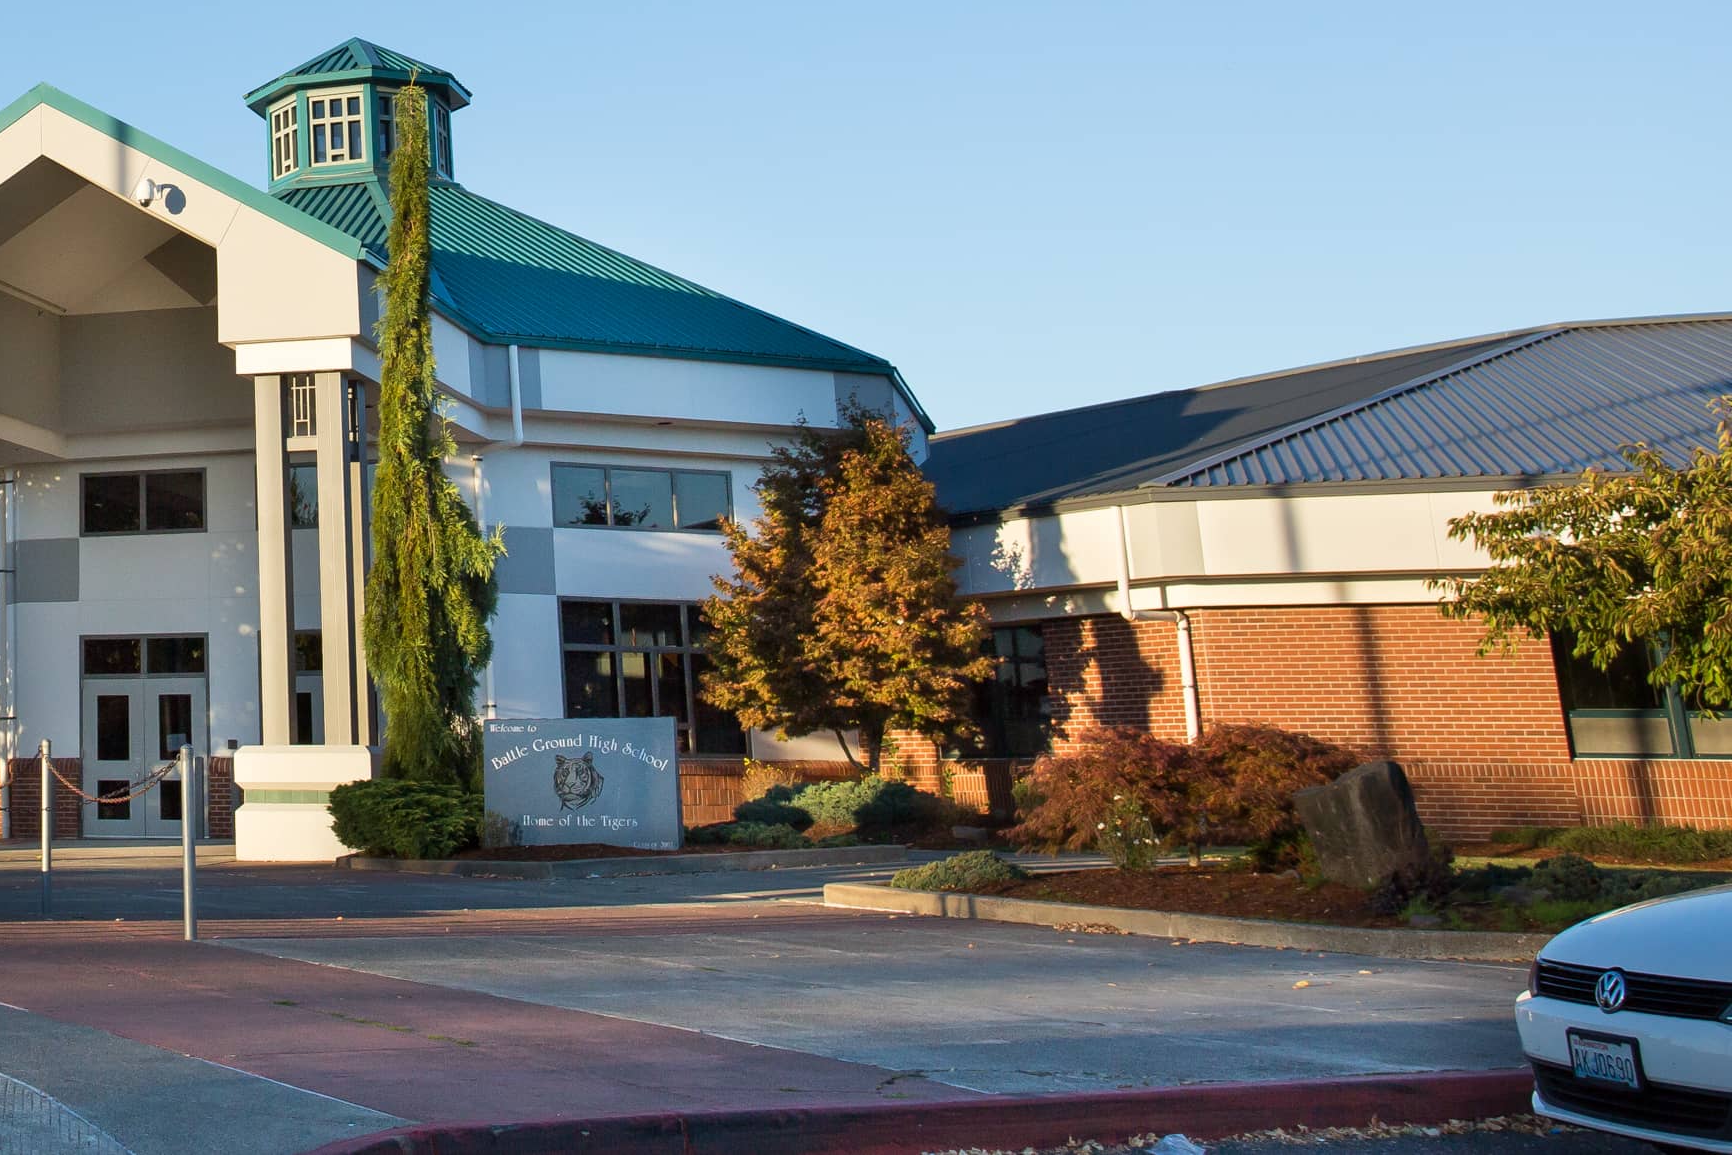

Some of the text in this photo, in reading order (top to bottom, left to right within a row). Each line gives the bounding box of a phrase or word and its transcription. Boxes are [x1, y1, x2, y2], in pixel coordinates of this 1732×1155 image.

[489, 723, 537, 733] Welcome to
[491, 733, 669, 771] Battle Ground High School
[523, 814, 638, 831] Home of the Tigers
